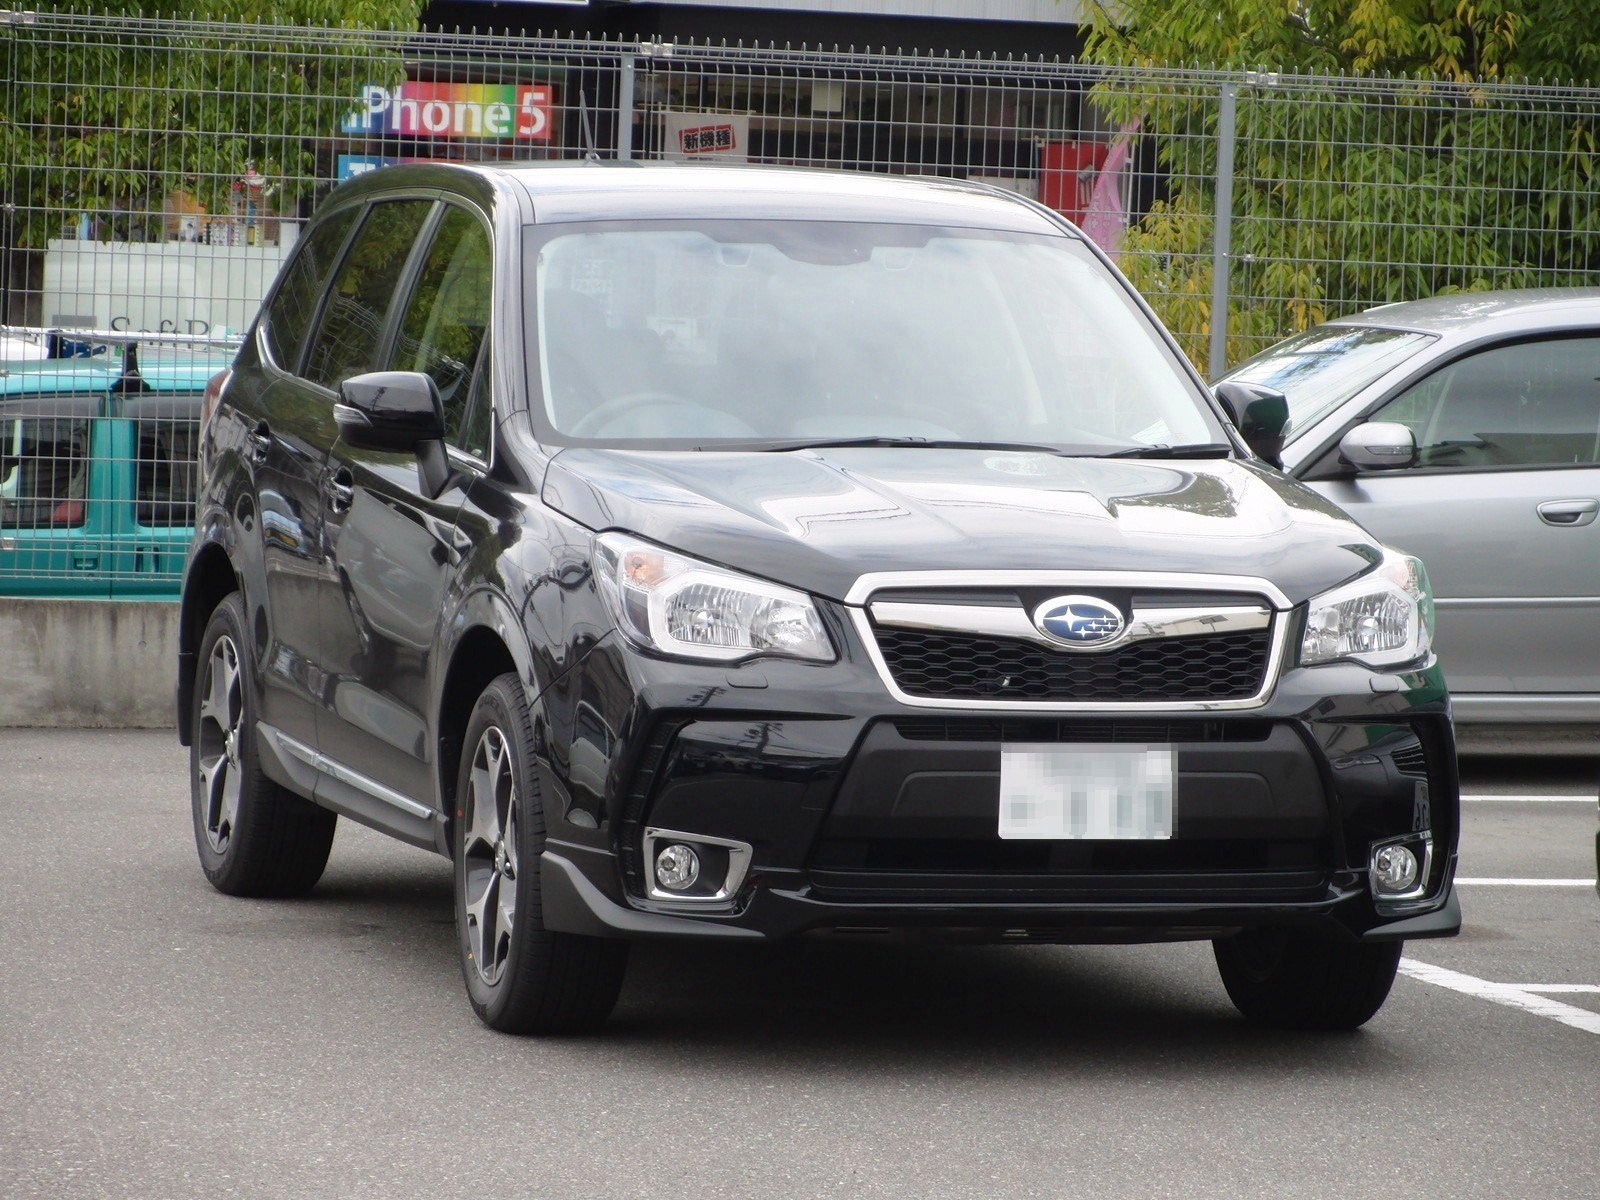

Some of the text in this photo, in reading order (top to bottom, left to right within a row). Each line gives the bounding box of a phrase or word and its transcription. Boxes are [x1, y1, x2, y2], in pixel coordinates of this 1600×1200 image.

[518, 91, 546, 135] 5
[682, 127, 732, 150] 新機種
